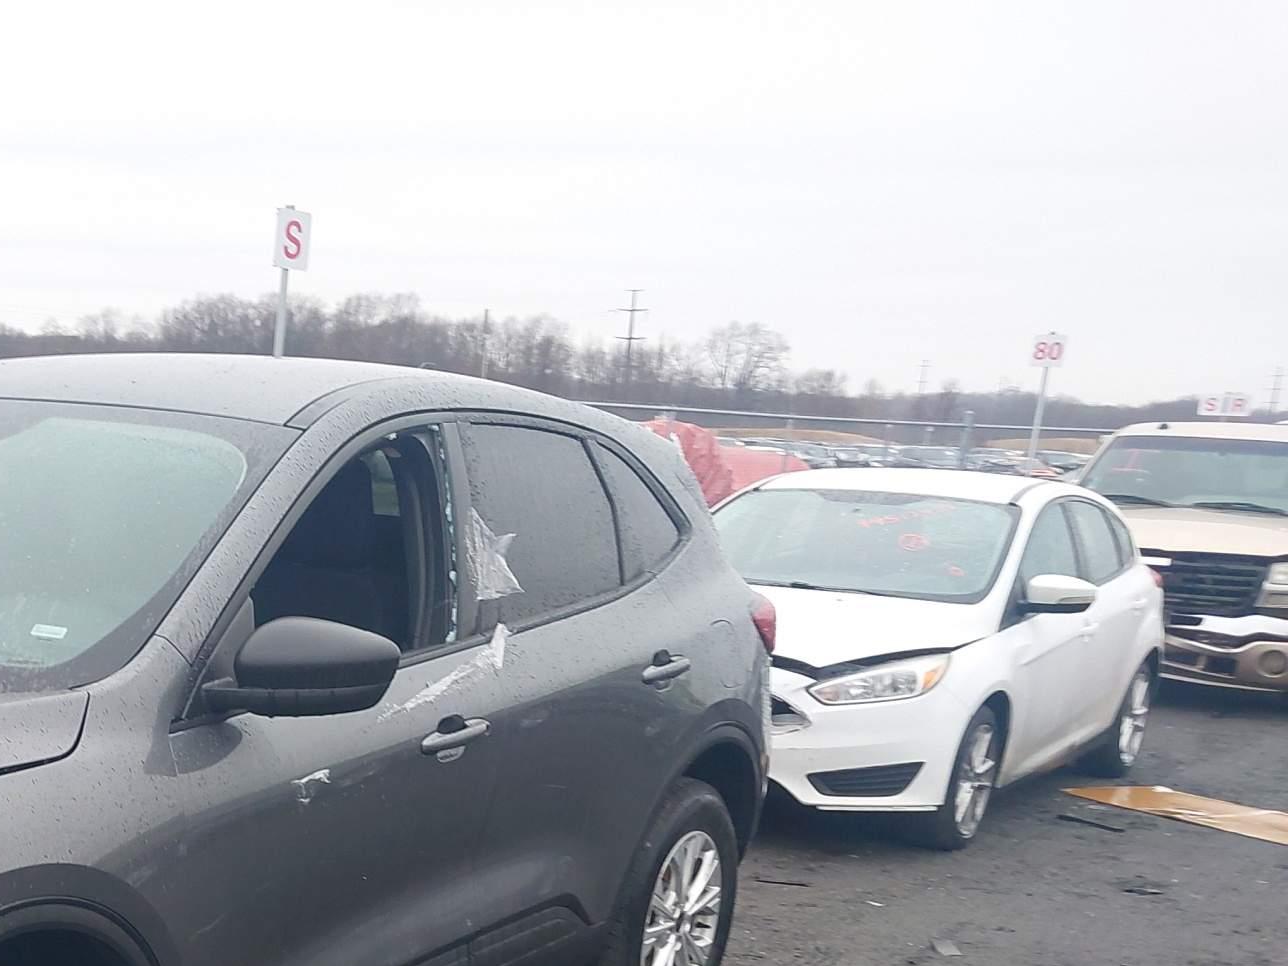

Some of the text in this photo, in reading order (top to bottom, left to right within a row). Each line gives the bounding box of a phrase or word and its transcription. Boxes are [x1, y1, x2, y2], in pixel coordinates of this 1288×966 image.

[284, 220, 302, 260] S
[1033, 341, 1064, 361] 80
[1203, 397, 1218, 412] S
